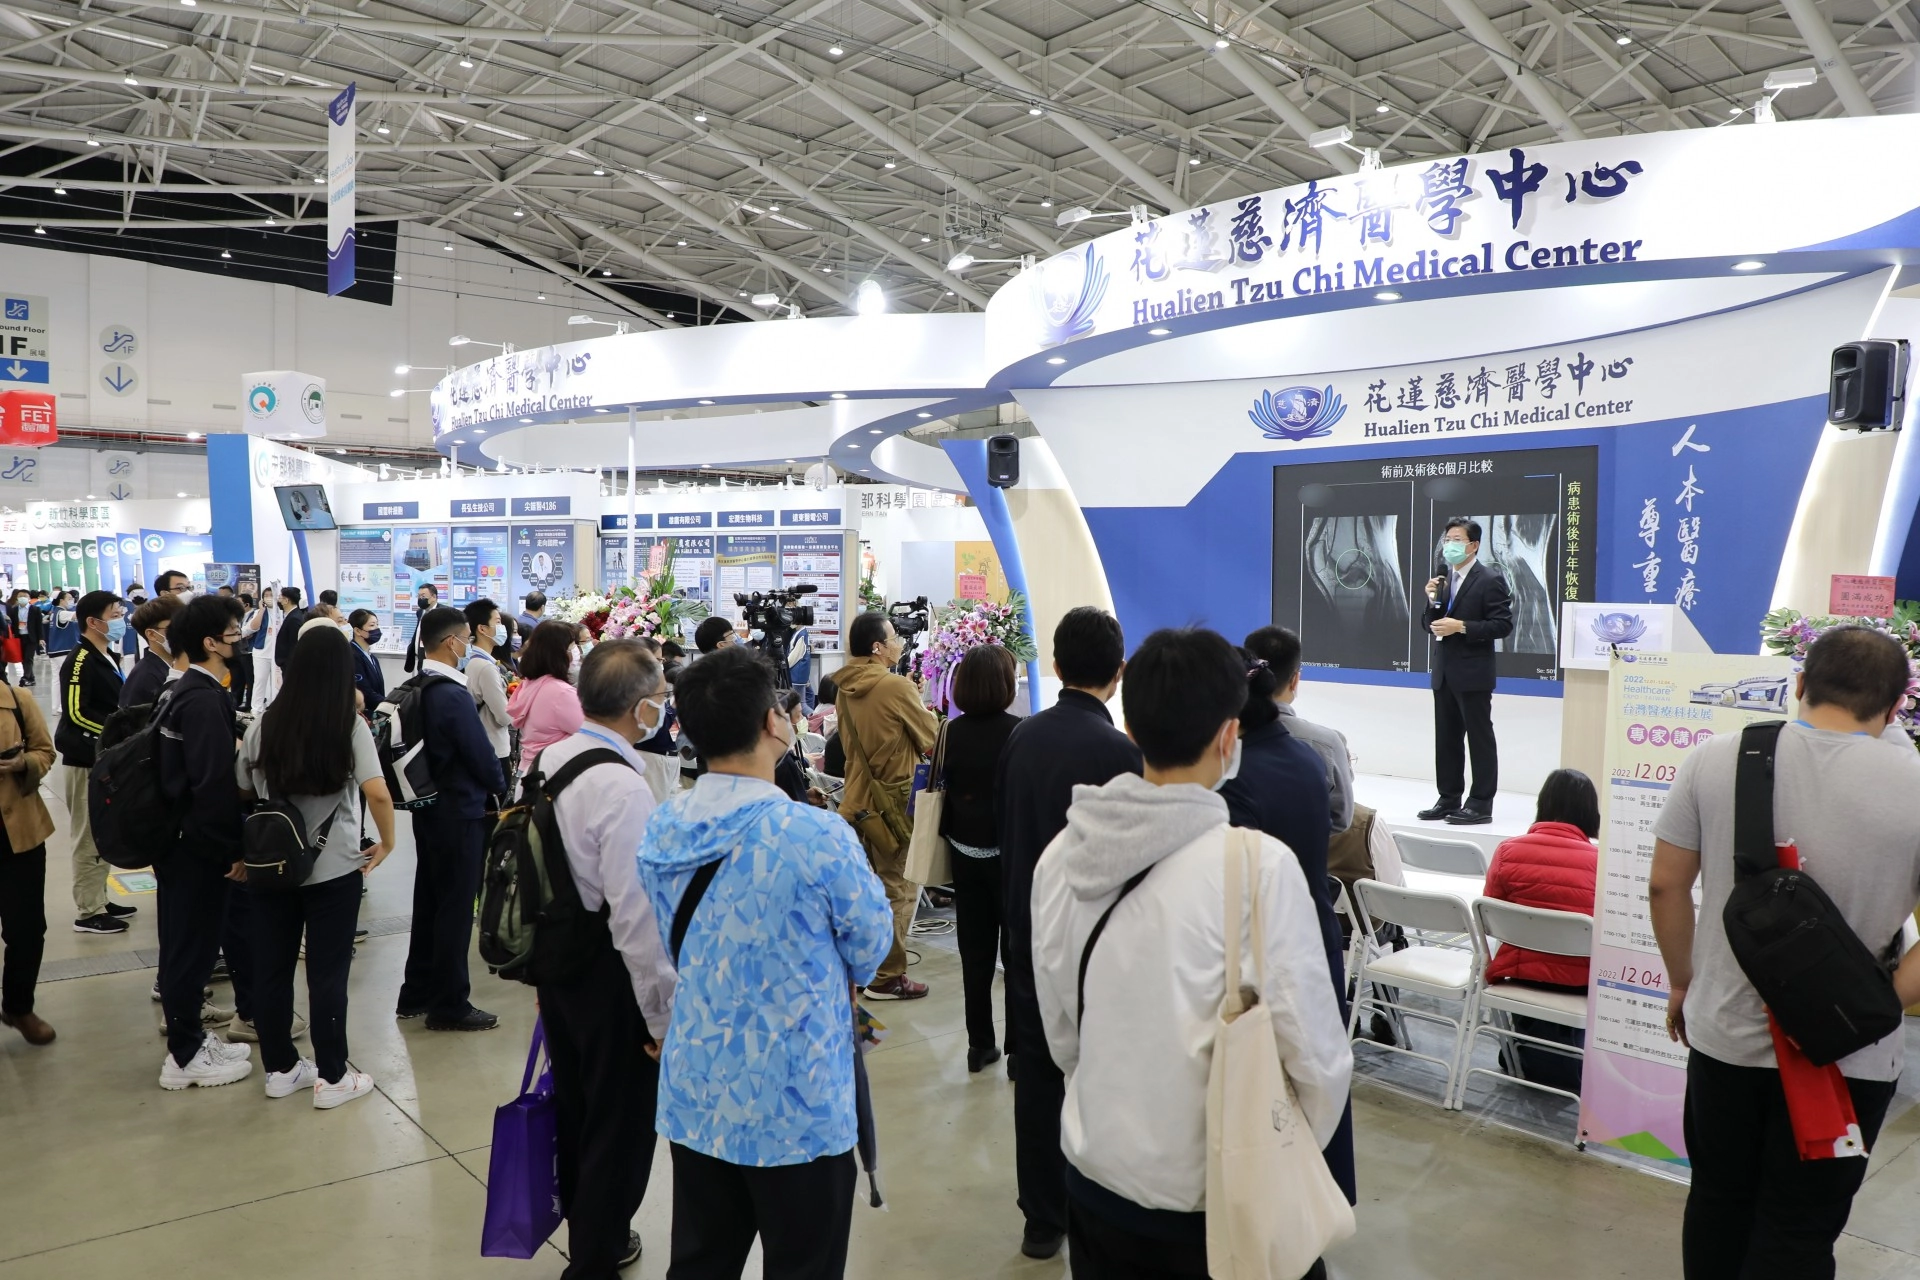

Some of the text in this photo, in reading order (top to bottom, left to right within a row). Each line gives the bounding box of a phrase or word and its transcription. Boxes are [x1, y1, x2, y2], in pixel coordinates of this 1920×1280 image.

[1130, 148, 1644, 282] 花蓮慈濟醫學中心
[1132, 236, 1644, 325] Hualien Tzu Chi Medical Center
[24, 326, 46, 334] Floor
[123, 346, 134, 354] 1F
[1364, 352, 1634, 413] 花蓮慈濟醫學中心
[21, 410, 52, 423] FET
[451, 394, 593, 430] Hualien Tzu Chi Medical Center
[1364, 399, 1634, 437] Hualien Tzu Chi Medical Center
[1381, 459, 1494, 478] 術前及術後6個月比較
[48, 506, 110, 519] 新竹科學園區
[1672, 424, 1710, 610] 人本醫療
[72, 520, 94, 528] Science
[1565, 481, 1581, 600] 病患術後半年恢復
[1633, 498, 1661, 604] 尊重
[1623, 675, 1644, 683] 2022
[1623, 685, 1671, 695] Healthcare
[1623, 703, 1713, 719] 台灣醫療科技展
[1611, 768, 1631, 777] 2022
[1598, 969, 1617, 979] 2022
